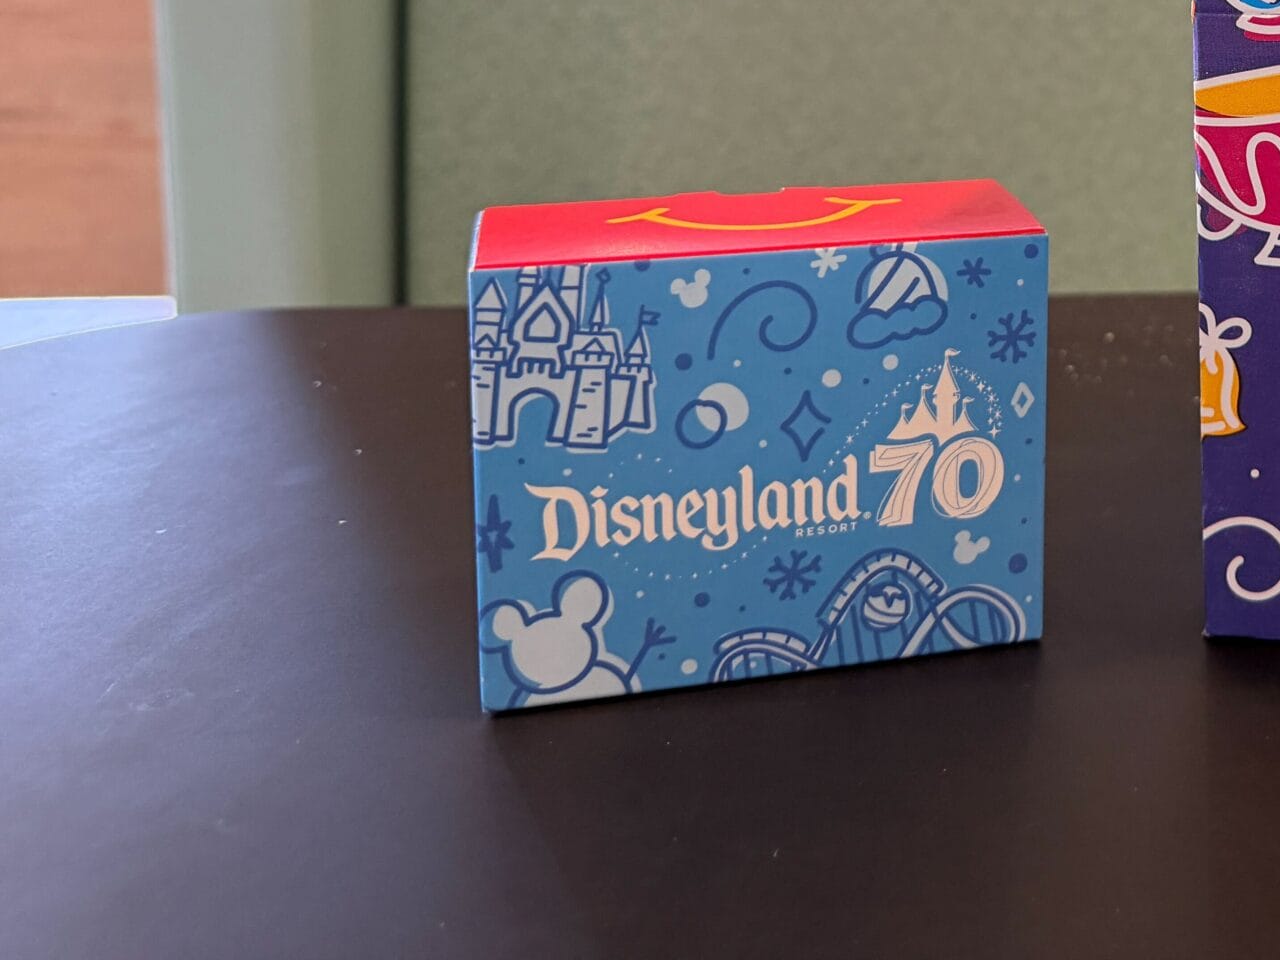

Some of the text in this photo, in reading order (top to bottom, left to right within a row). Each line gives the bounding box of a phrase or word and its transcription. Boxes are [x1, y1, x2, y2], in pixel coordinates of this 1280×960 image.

[524, 437, 1005, 562] Disneyland 70
[795, 521, 857, 538] RESORT
